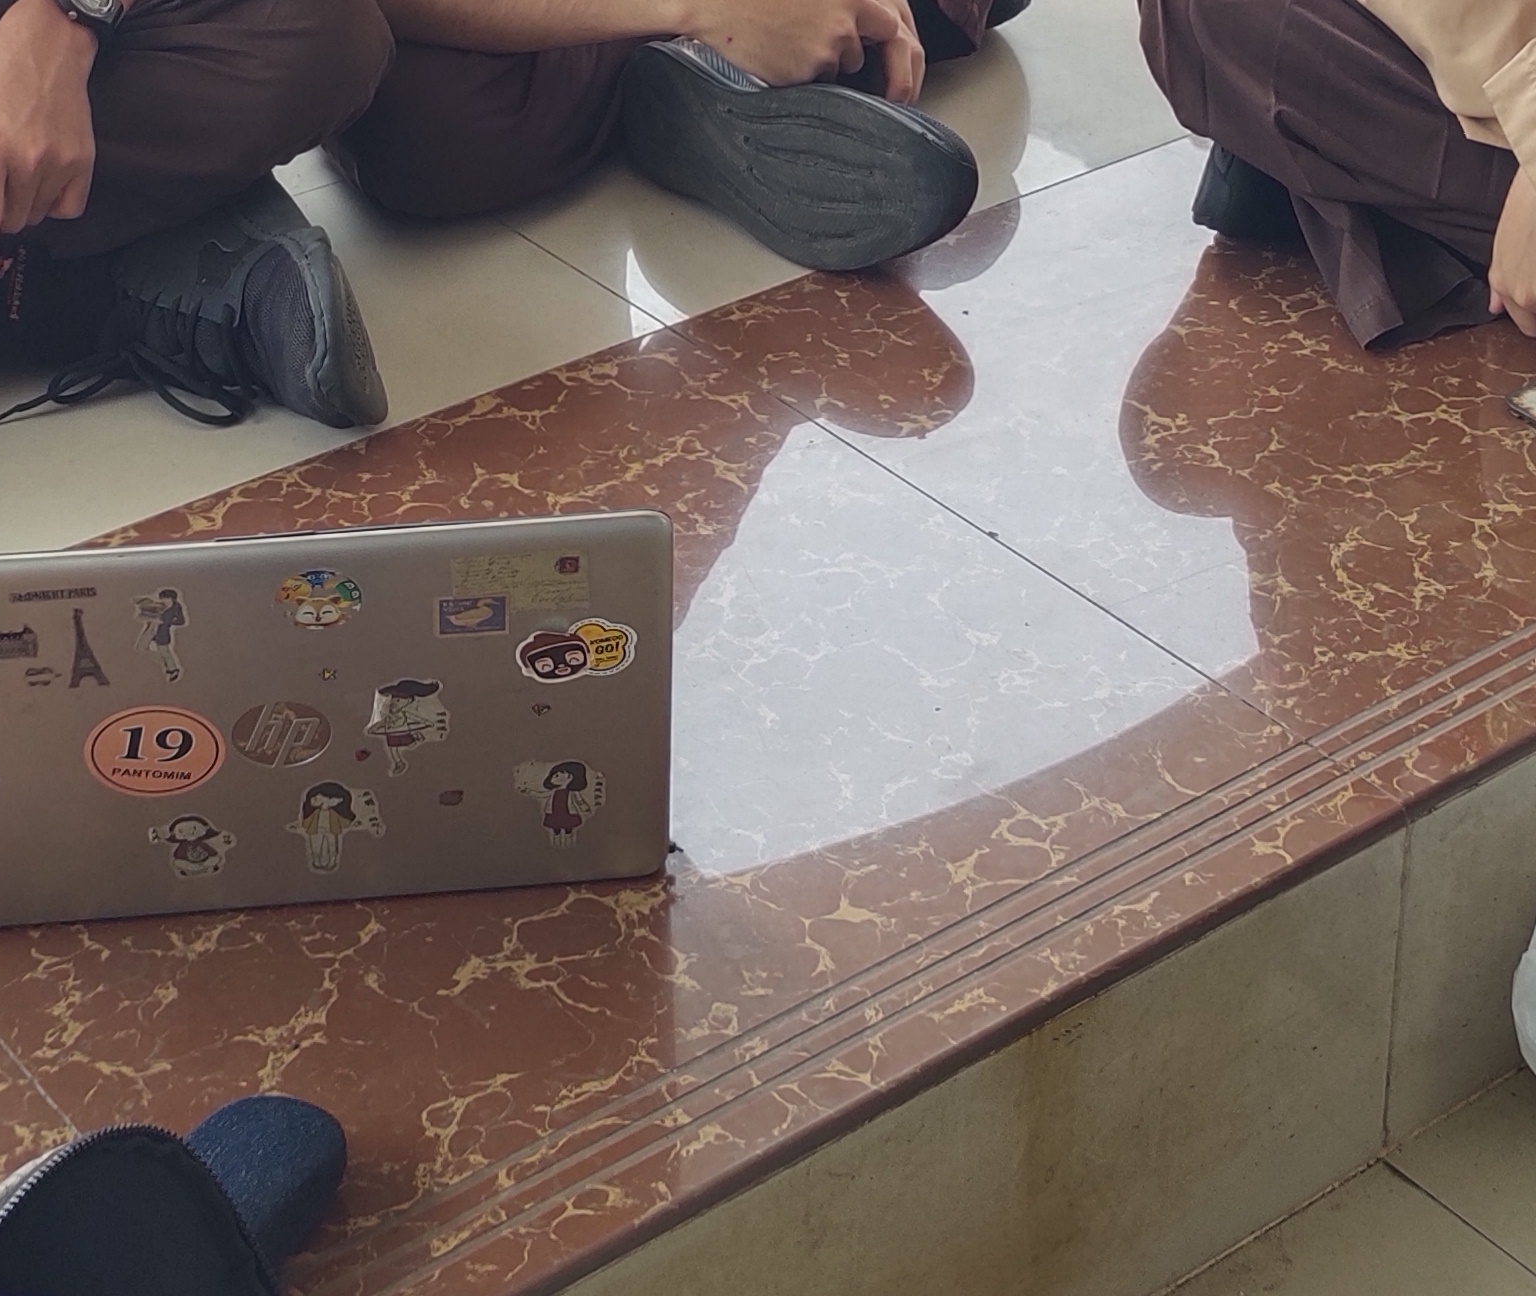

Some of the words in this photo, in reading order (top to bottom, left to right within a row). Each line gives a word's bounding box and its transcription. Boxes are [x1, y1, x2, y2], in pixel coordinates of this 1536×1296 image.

[595, 641, 619, 655] GO!
[118, 725, 195, 763] 19
[244, 703, 321, 767] hp
[111, 767, 192, 780] PANTOMIM
